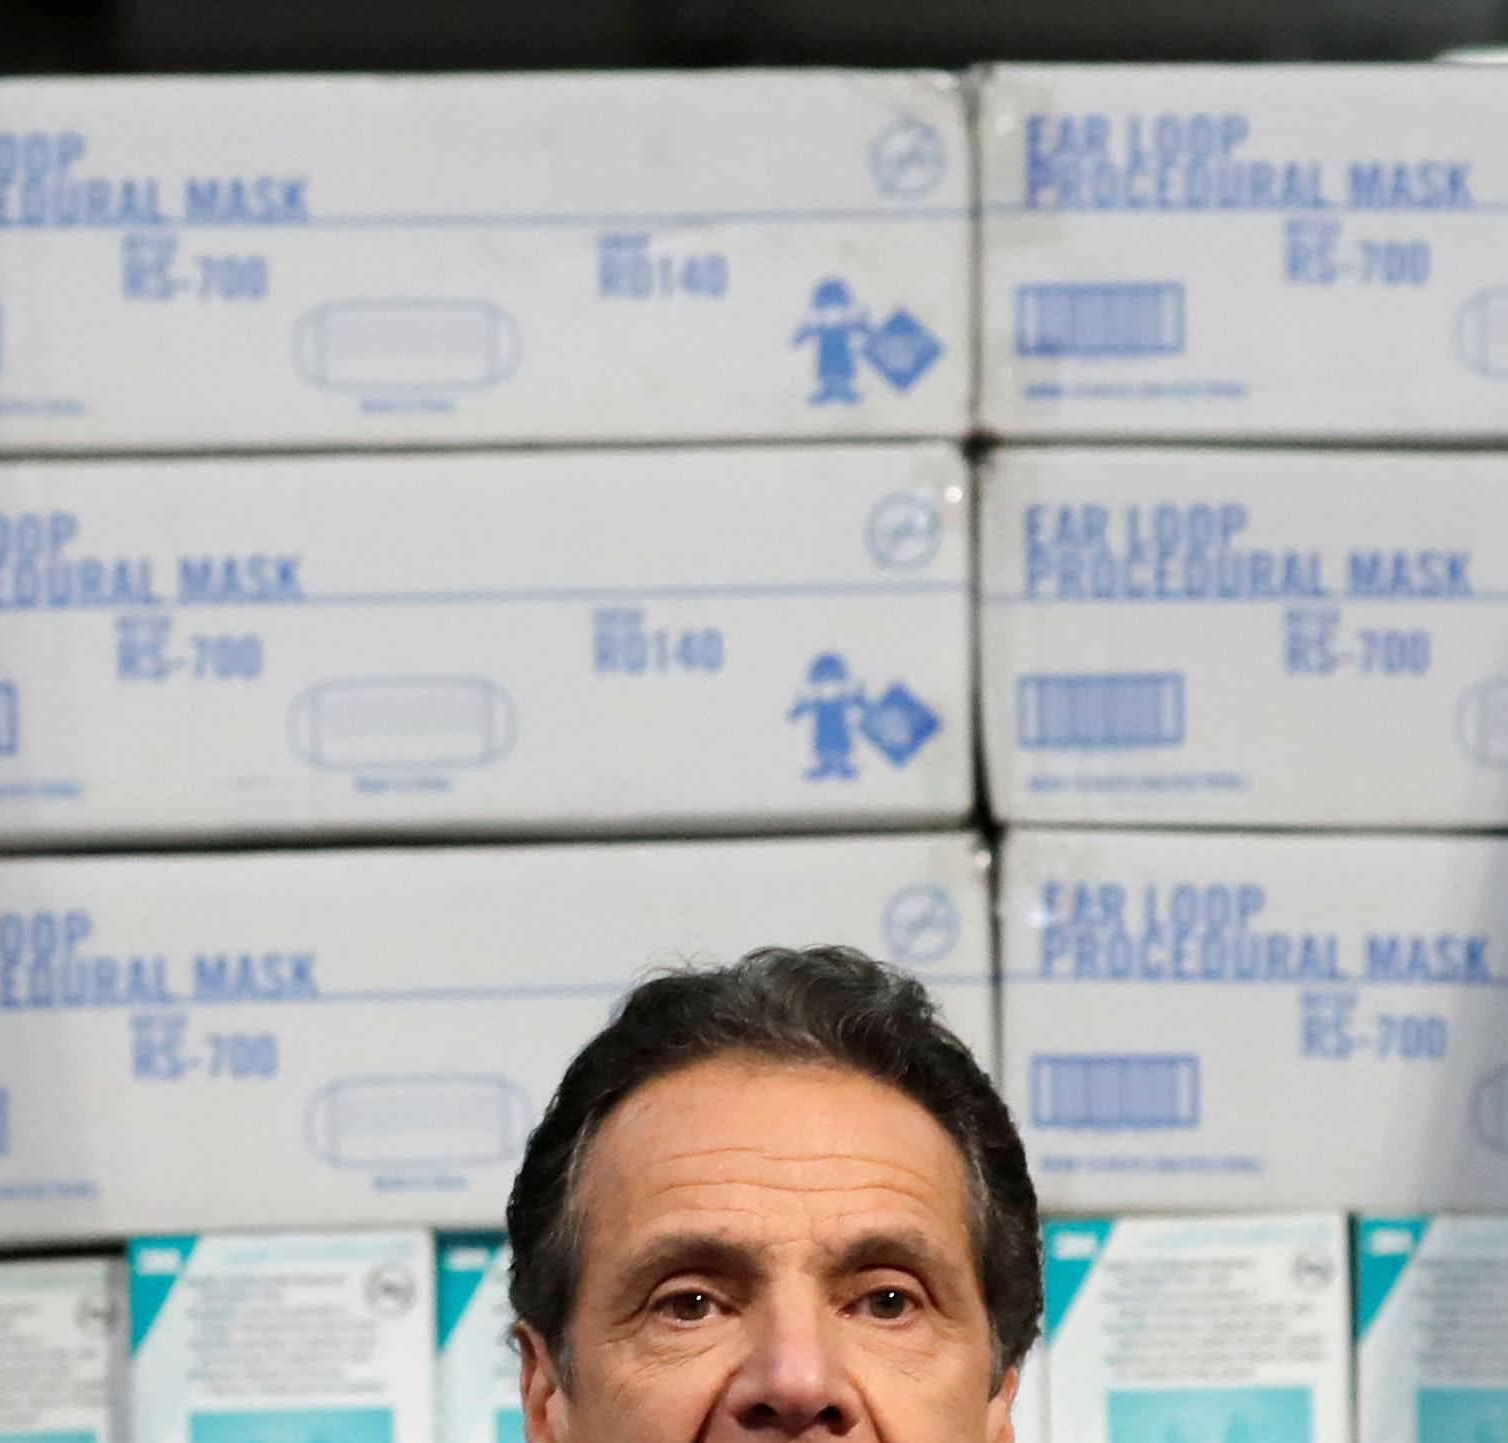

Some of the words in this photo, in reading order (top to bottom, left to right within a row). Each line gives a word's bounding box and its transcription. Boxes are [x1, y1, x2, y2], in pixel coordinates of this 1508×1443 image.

[1024, 114, 1110, 160] EAR
[1127, 114, 1250, 160] LOOP
[185, 176, 309, 225] MASK
[1024, 157, 1331, 209] PROCEDURAL
[1349, 161, 1472, 208] MASK
[1024, 504, 1109, 550] EAR
[1126, 504, 1249, 550] LOOP
[177, 555, 302, 605] MASK
[1024, 547, 1329, 599] PROCEDURAL
[1348, 551, 1472, 597] MASK
[1043, 881, 1126, 928] EAR
[1144, 882, 1266, 930] LOOP
[194, 952, 319, 1001] MASK
[1040, 926, 1343, 980] PROCEDURAL
[1367, 934, 1492, 984] MASK
